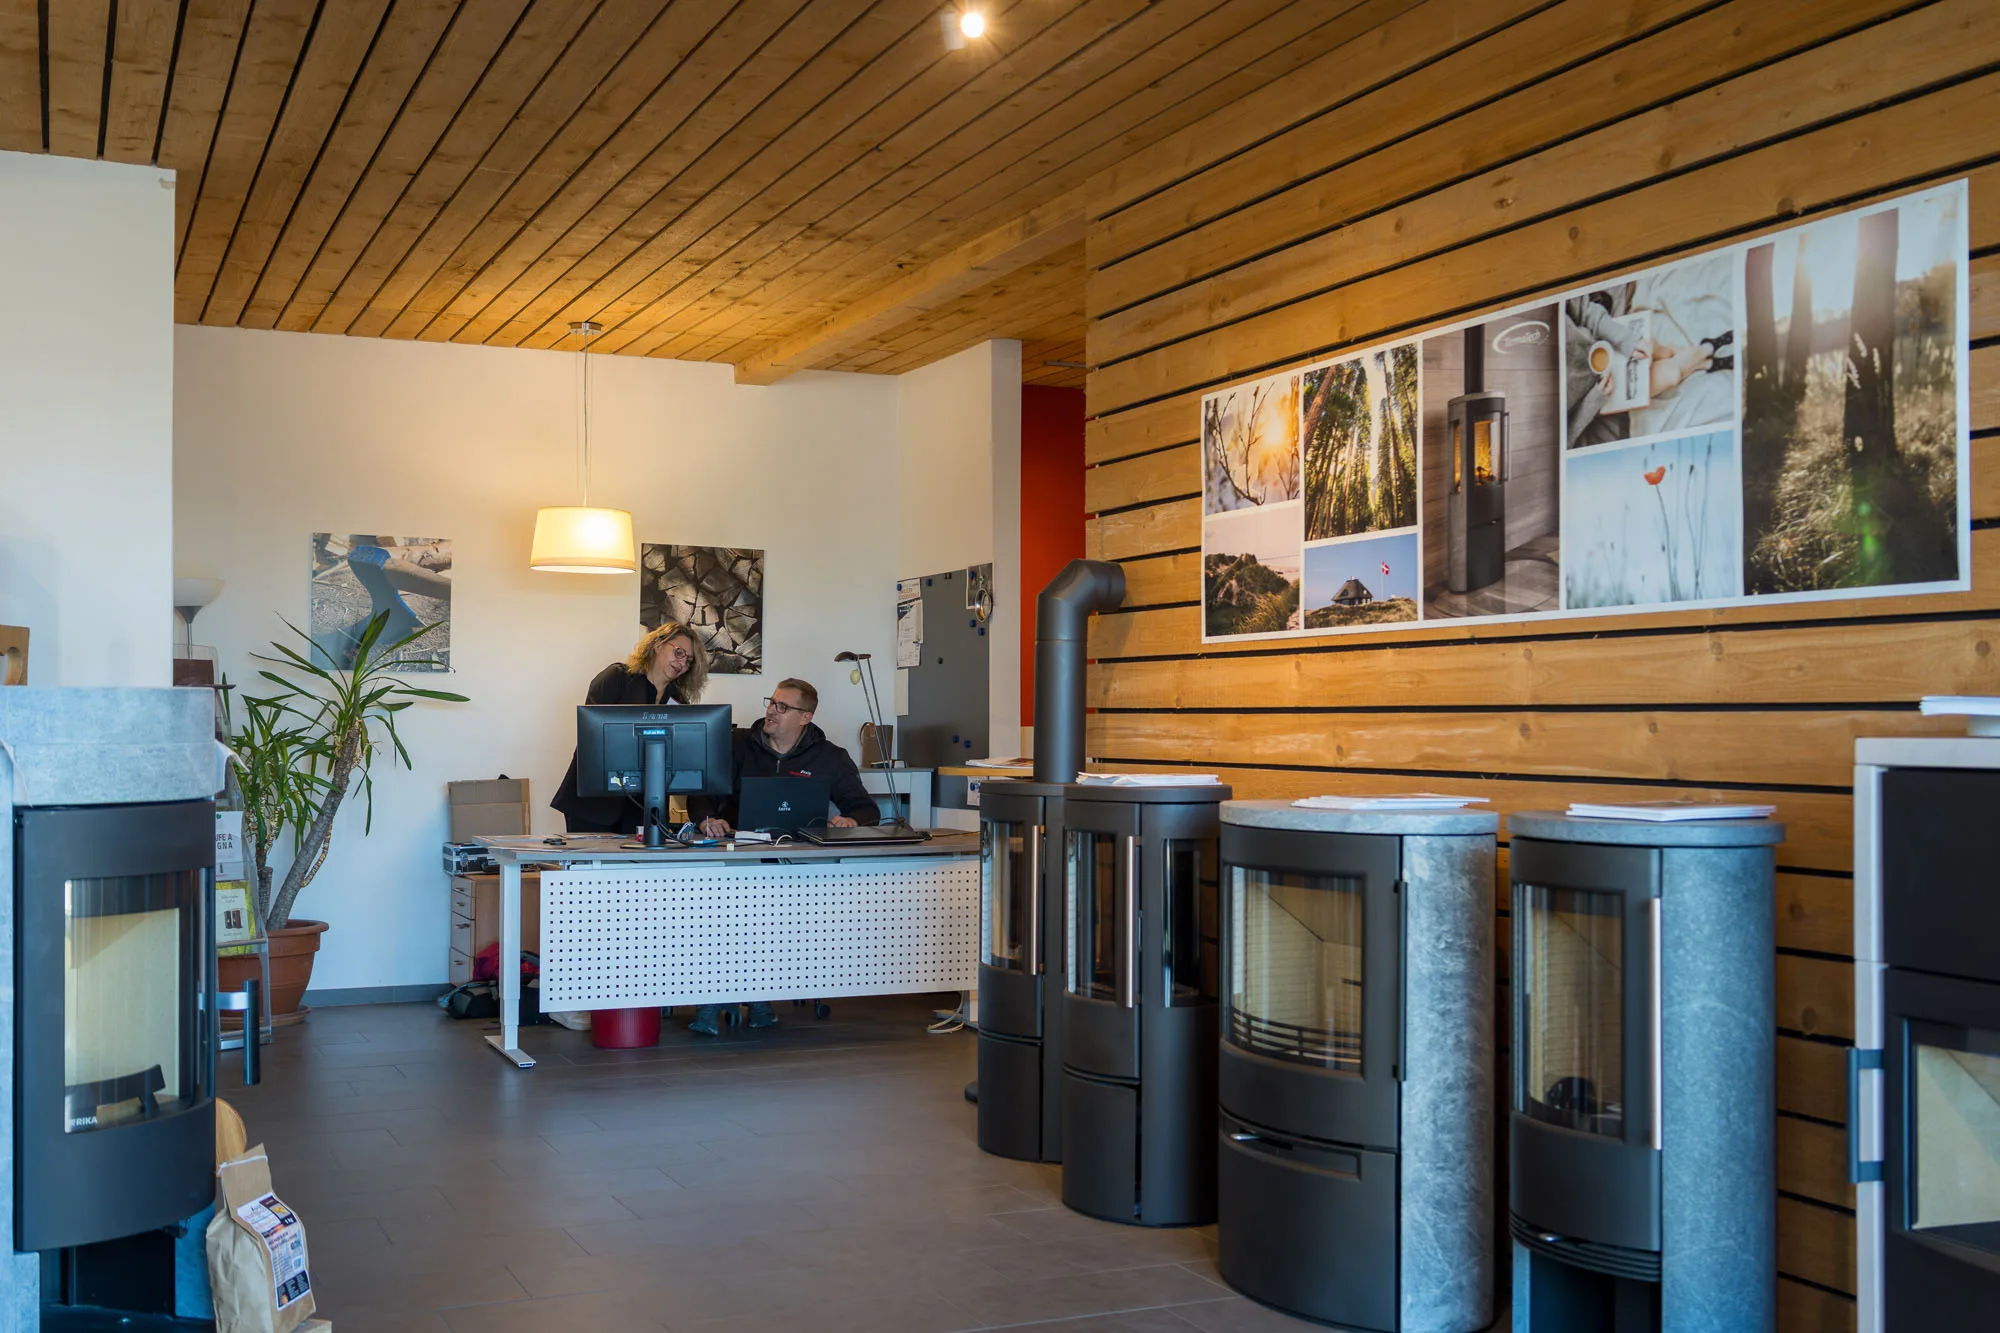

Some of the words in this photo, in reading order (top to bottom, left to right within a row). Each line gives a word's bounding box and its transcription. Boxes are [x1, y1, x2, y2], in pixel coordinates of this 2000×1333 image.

[215, 833, 226, 842] UFE
[227, 833, 233, 841] A
[217, 842, 233, 850] GNA
[76, 1116, 98, 1126] RIKA
